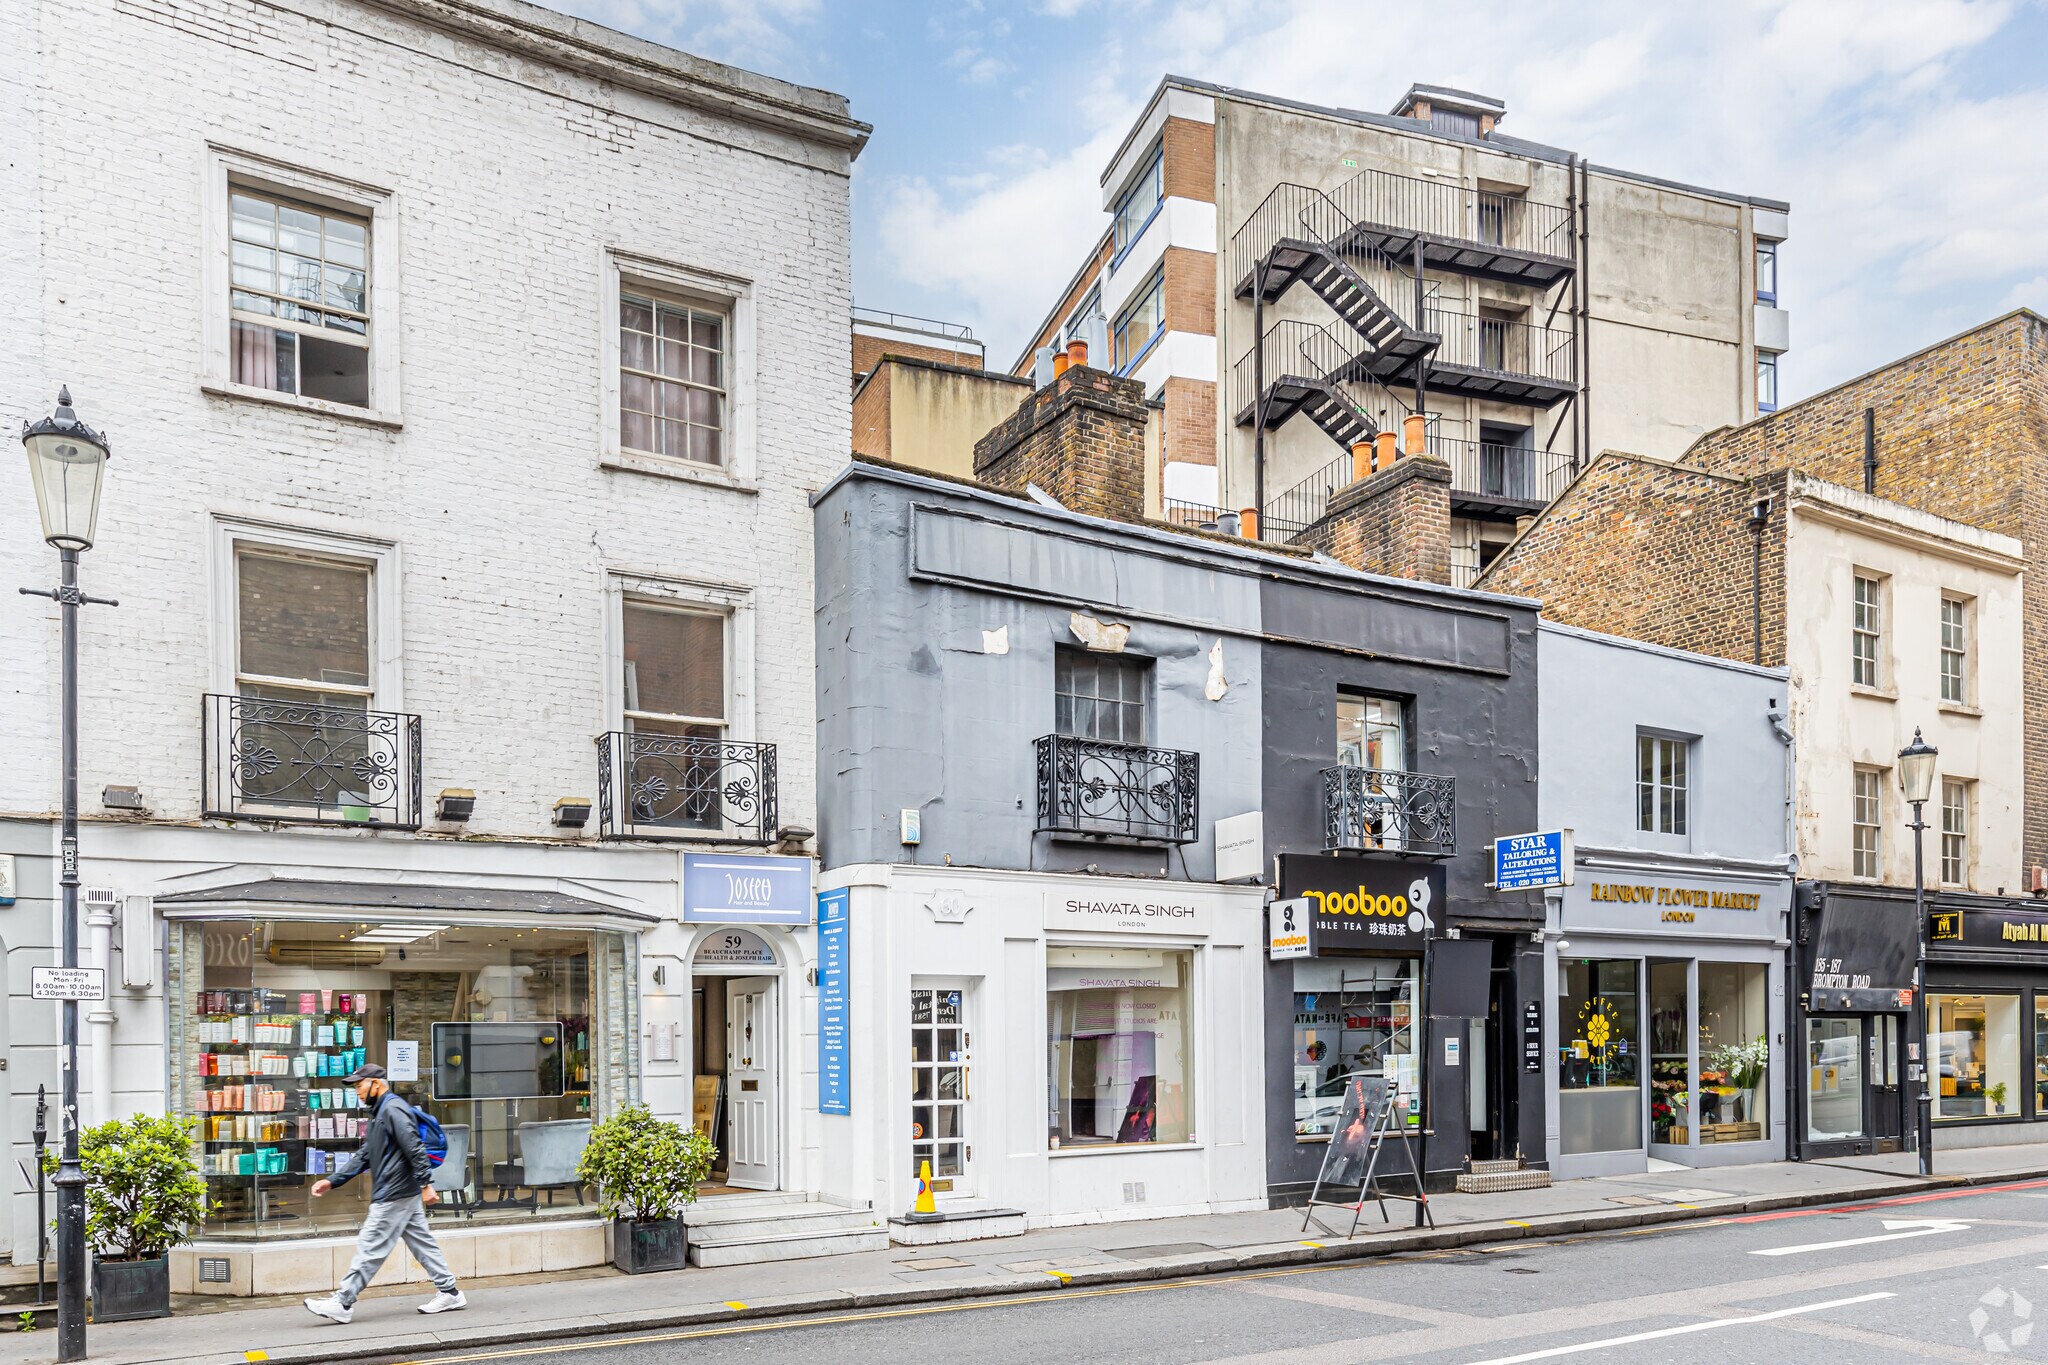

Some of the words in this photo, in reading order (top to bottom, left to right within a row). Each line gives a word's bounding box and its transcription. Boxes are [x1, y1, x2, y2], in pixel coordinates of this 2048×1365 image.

[1217, 843, 1238, 852] SHAVATA
[1239, 838, 1255, 847] SINGH
[1511, 835, 1547, 851] STAR
[1503, 849, 1547, 860] TAILORING
[1502, 856, 1556, 869] ALTERATIONS
[725, 873, 772, 905] JOSEPH
[1301, 885, 1408, 917] mooboo
[1591, 883, 1654, 903] RAINBOW
[1657, 887, 1709, 908] FLOWER
[1711, 891, 1761, 910] MARKET
[1066, 900, 1141, 915] SHAVATA
[1144, 904, 1195, 918] SINGH
[1661, 911, 1696, 923] LONDON
[1343, 922, 1362, 931] TEA
[1368, 922, 1407, 936] 珍珠奶茶
[2002, 921, 2029, 942] Atyab
[725, 936, 742, 948] 59
[1272, 934, 1307, 947] mooboo
[1830, 958, 1843, 973] 187
[62, 970, 89, 978] loading
[1812, 973, 1850, 989] BROMPTON
[1851, 974, 1871, 989] ROAD
[1079, 978, 1127, 987] SHAVATA
[1128, 979, 1161, 988] SINGH
[1578, 997, 1618, 1019] COFFEE
[1295, 1122, 1321, 1134] pen
